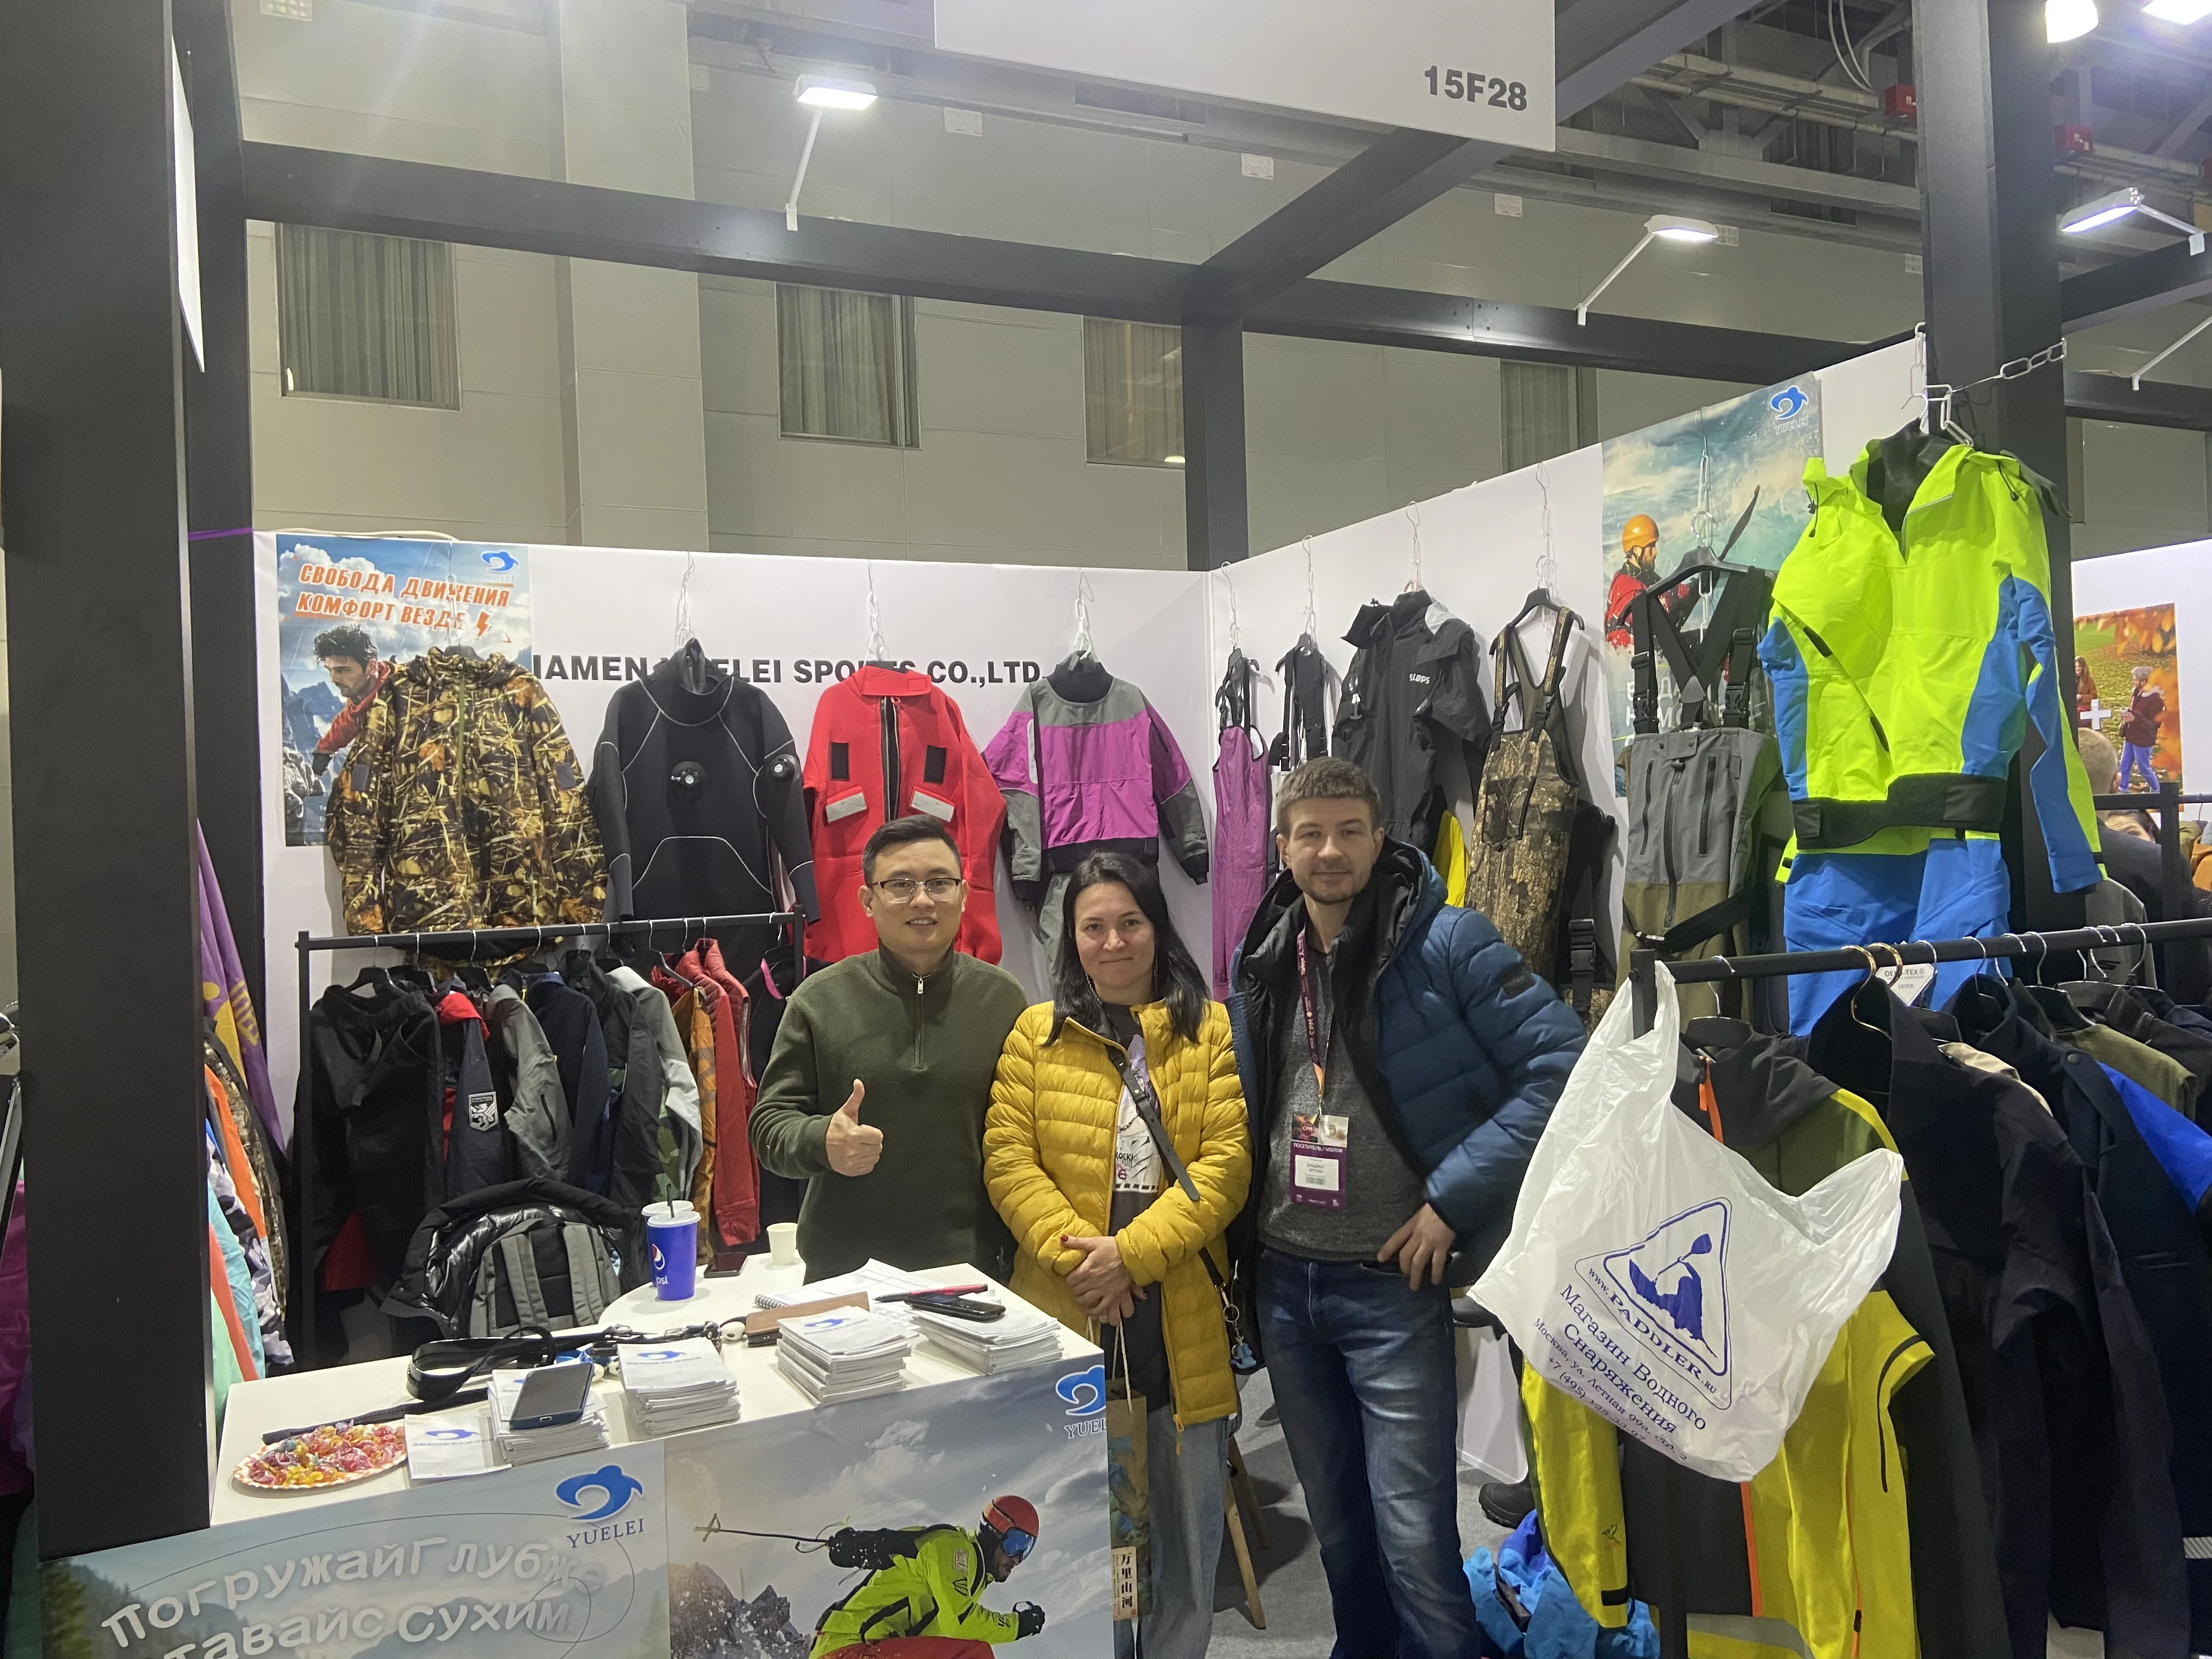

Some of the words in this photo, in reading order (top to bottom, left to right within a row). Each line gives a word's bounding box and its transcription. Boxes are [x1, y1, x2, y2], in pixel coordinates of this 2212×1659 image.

[1424, 65, 1527, 111] 15F28
[1774, 416, 1809, 435] YUELEI
[297, 592, 396, 621] КОМФОРТ
[300, 565, 396, 595] СВОБОДА
[400, 578, 510, 607] ДВИЖЕНИЯ
[533, 654, 647, 681] IAMEN
[927, 661, 1047, 688] CO.,LTD
[1884, 968, 1925, 977] OE-TEX®
[1533, 1318, 1569, 1361] Москва,
[1570, 1361, 1585, 1378] ул.
[1588, 1378, 1626, 1415] Летная
[1560, 1283, 1631, 1366] Магазин
[1632, 1362, 1706, 1430] Водного
[1549, 1357, 1561, 1370] +7
[1559, 1372, 1586, 1398] (495)
[1565, 1324, 1677, 1434] Снаряжения
[1064, 1418, 1107, 1439] YUEL
[567, 1518, 645, 1549] YUELEI
[1121, 1552, 1133, 1609] 万里山河
